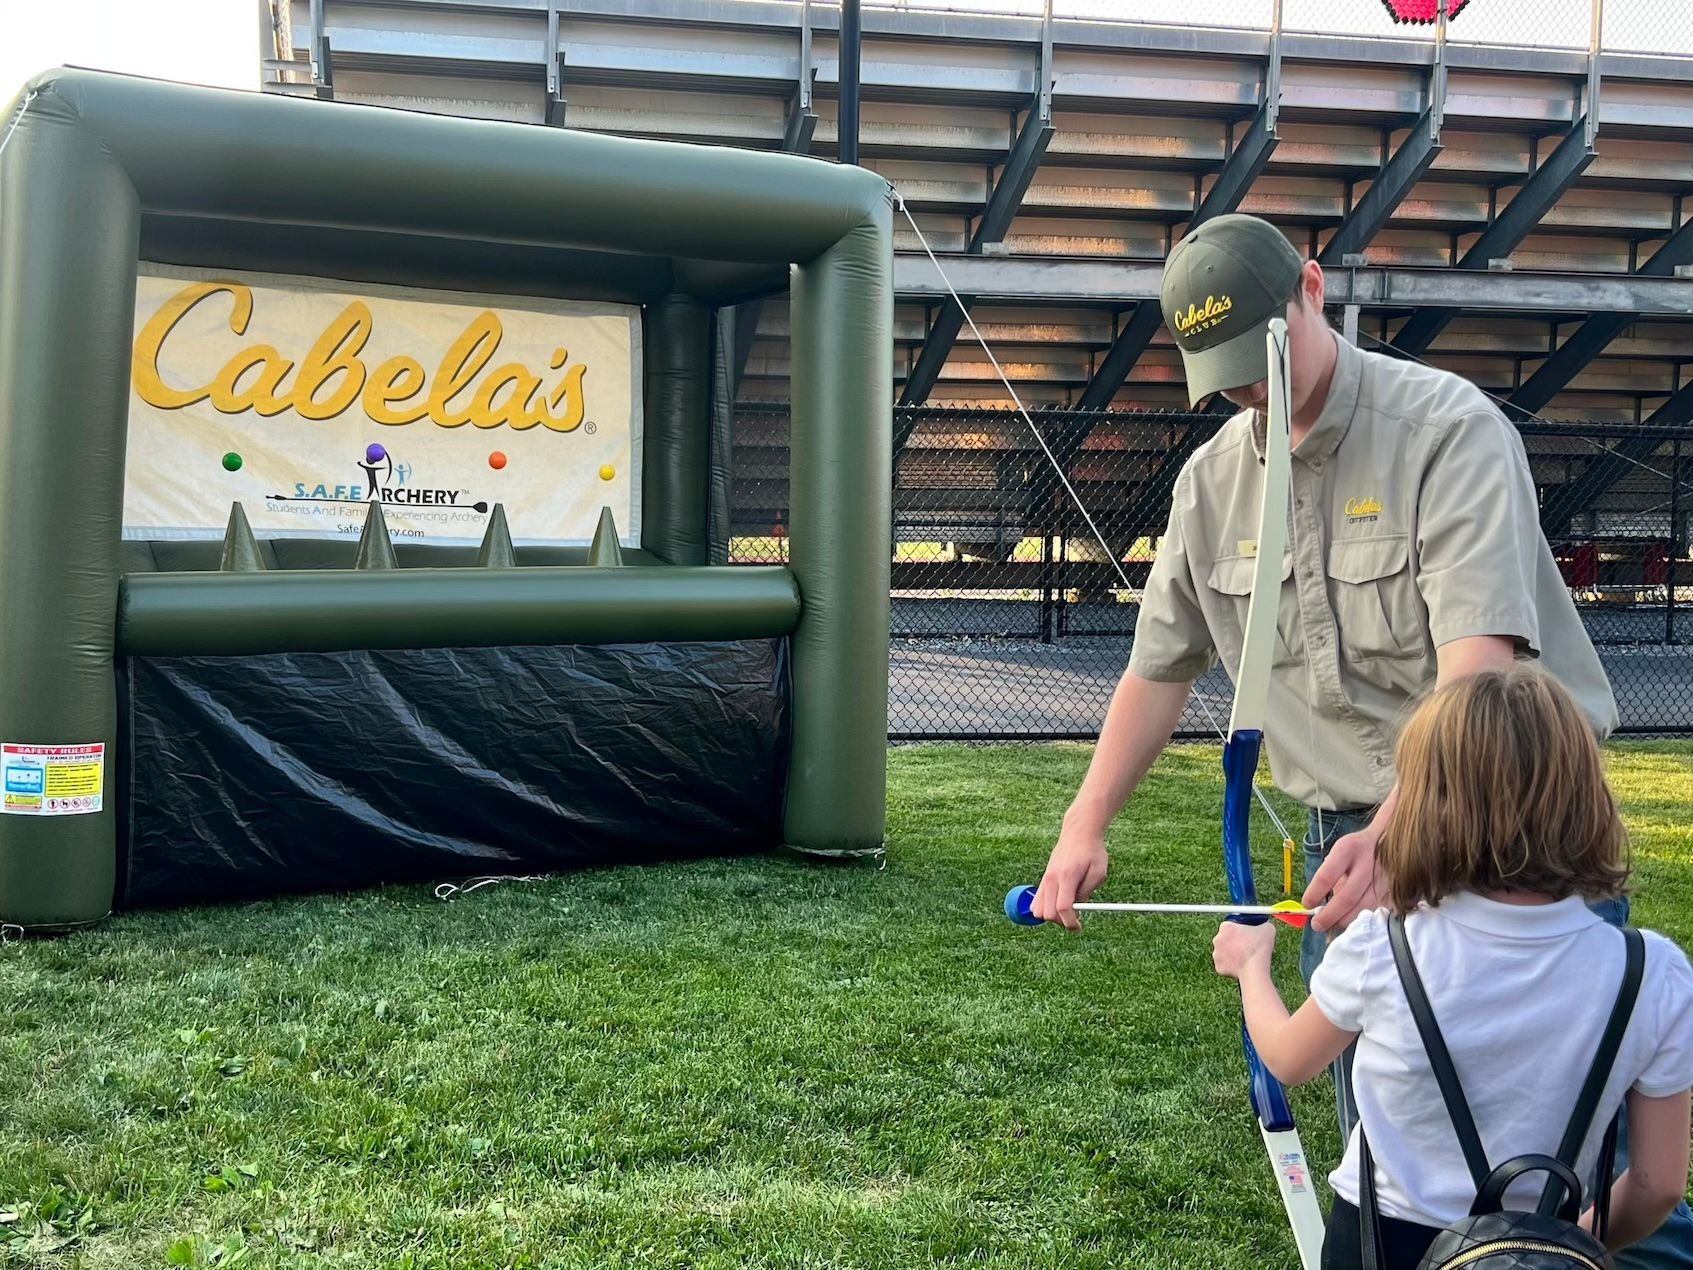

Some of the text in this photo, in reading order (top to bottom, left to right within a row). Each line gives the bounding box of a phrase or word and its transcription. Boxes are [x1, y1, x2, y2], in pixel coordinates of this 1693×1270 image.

[1175, 295, 1233, 331] Cabela's
[132, 279, 587, 433] Cabela's
[294, 483, 362, 501] S.A.F.E
[266, 502, 311, 514] Students
[312, 505, 336, 517] And
[384, 509, 448, 524] Experiencing
[450, 511, 488, 524] Archery
[17, 746, 92, 755] SAFETY RULES
